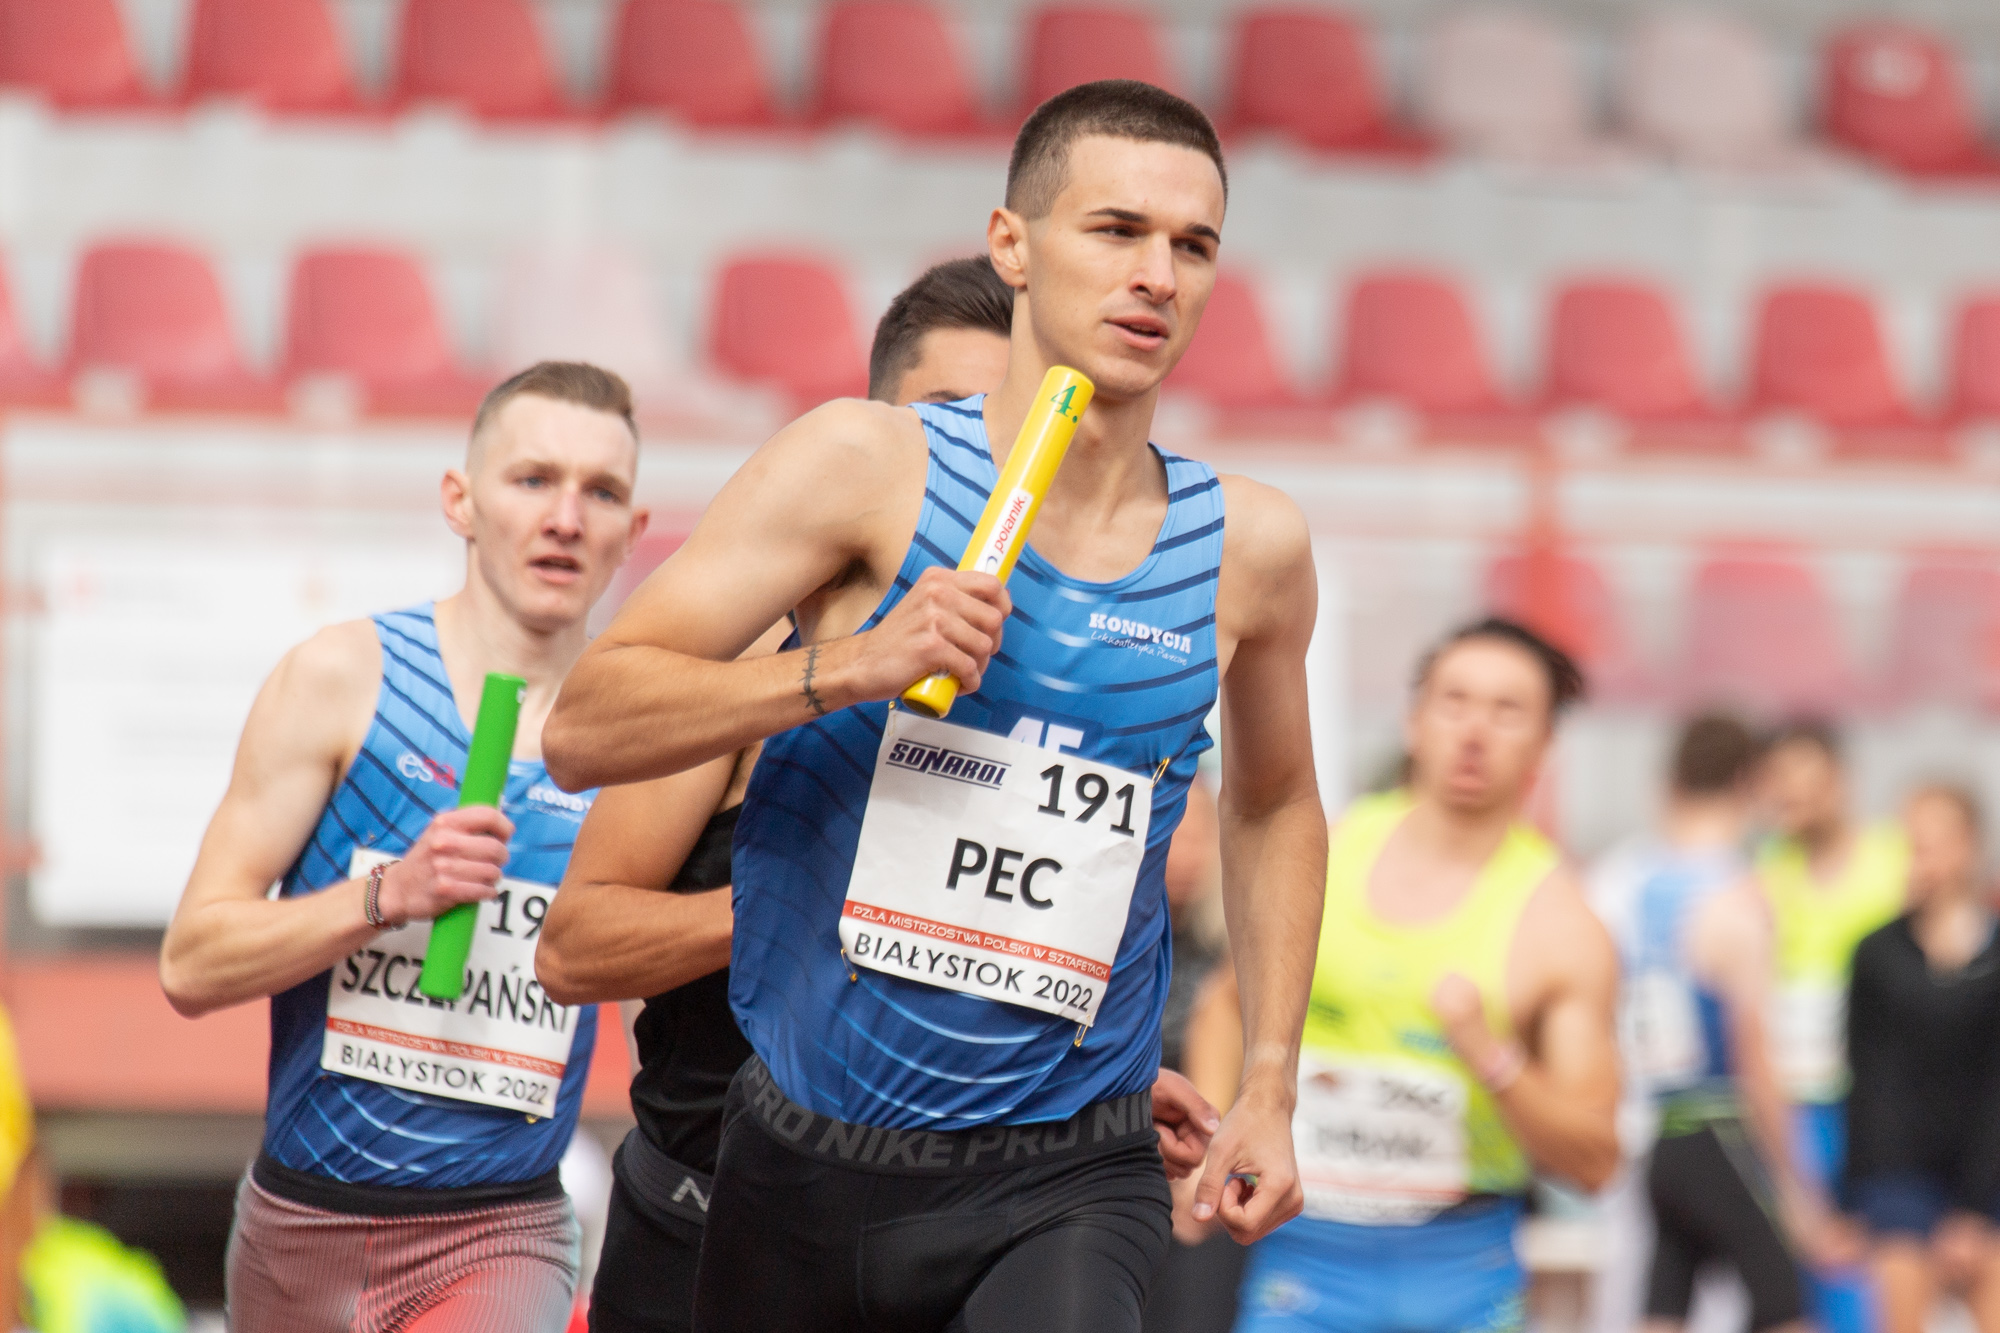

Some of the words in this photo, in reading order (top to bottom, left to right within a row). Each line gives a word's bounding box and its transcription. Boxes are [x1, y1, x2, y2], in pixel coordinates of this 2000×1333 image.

[1050, 385, 1078, 424] 4.
[994, 496, 1026, 555] polanik
[1037, 764, 1136, 838] 191
[945, 837, 1063, 911] PEC
[852, 905, 886, 922] PZLA
[887, 914, 980, 946] MISTRZOSTWA
[983, 936, 1030, 957] POLSKI
[1032, 947, 1047, 960] W
[1047, 951, 1108, 979] SZTAFETACH
[853, 932, 1025, 994] BIAŁYSTOK
[1032, 974, 1093, 1013] 2022
[341, 1044, 487, 1094] BIAŁYSTOK
[496, 1075, 549, 1106] 2022
[815, 1118, 954, 1168] NIKE
